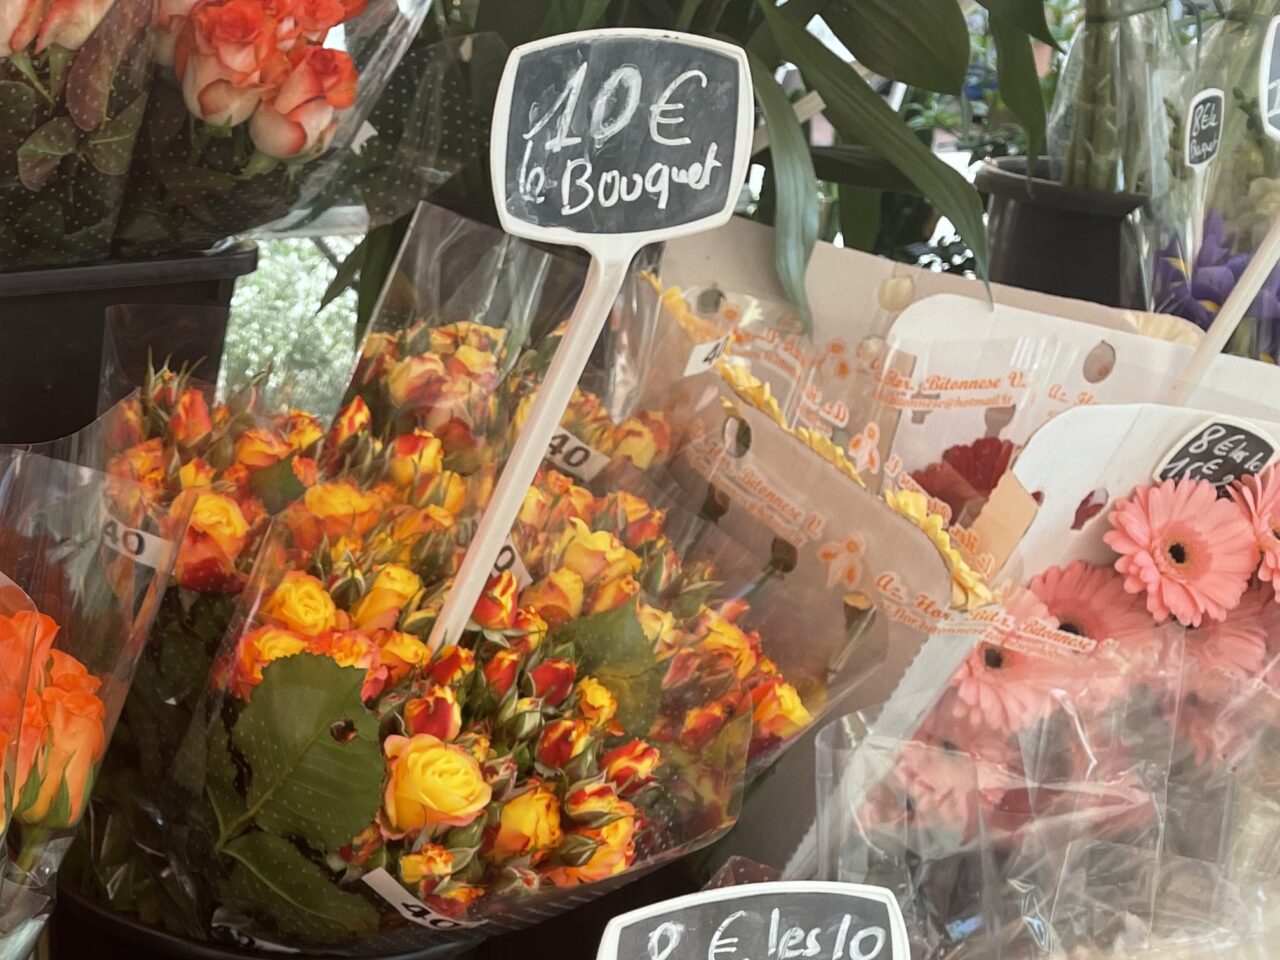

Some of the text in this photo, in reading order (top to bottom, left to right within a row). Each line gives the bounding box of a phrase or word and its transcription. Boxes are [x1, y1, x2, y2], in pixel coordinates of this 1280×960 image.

[561, 142, 722, 215] Bouquet
[549, 433, 590, 467] 40
[104, 520, 145, 556] 40
[494, 544, 516, 573] 0
[768, 907, 822, 959] les
